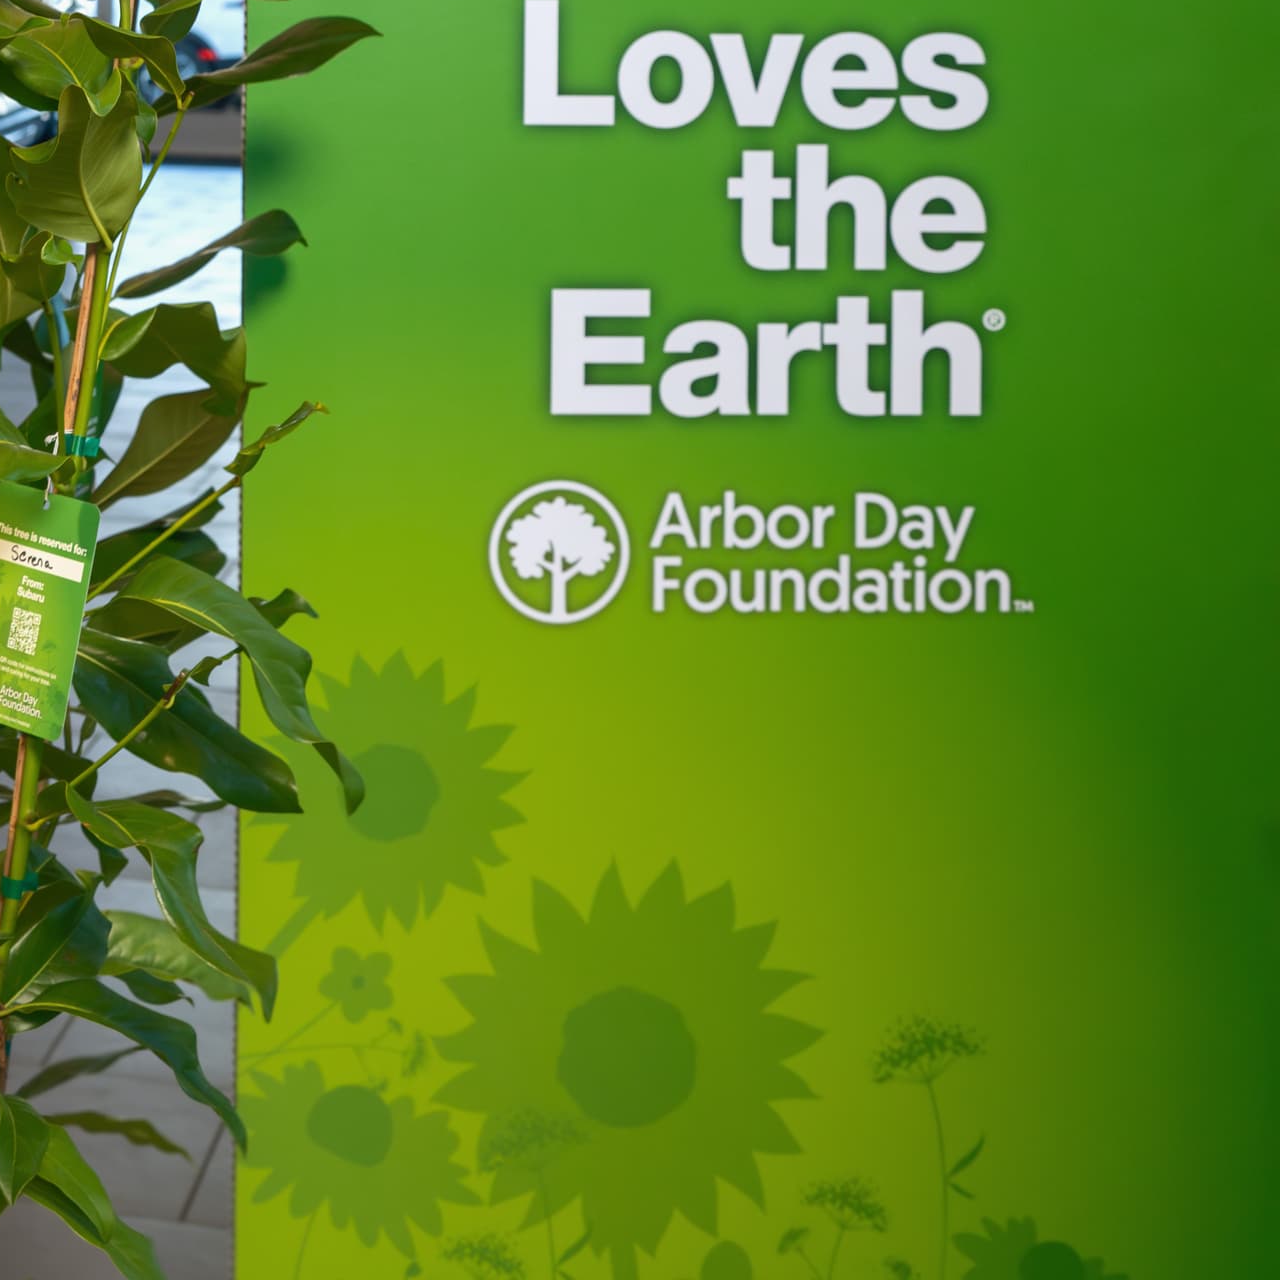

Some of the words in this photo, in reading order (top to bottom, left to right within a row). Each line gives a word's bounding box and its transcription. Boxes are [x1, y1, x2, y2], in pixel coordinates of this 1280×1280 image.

[727, 144, 987, 274] the
[650, 490, 835, 550] Arbor
[854, 492, 975, 562] Day
[14, 527, 30, 540] tree
[30, 531, 38, 543] is
[38, 536, 73, 552] reserved
[73, 543, 88, 557] for:
[16, 585, 45, 604] Subaru
[21, 575, 45, 591] From:
[0, 685, 22, 700] Arbor
[23, 691, 39, 707] Day
